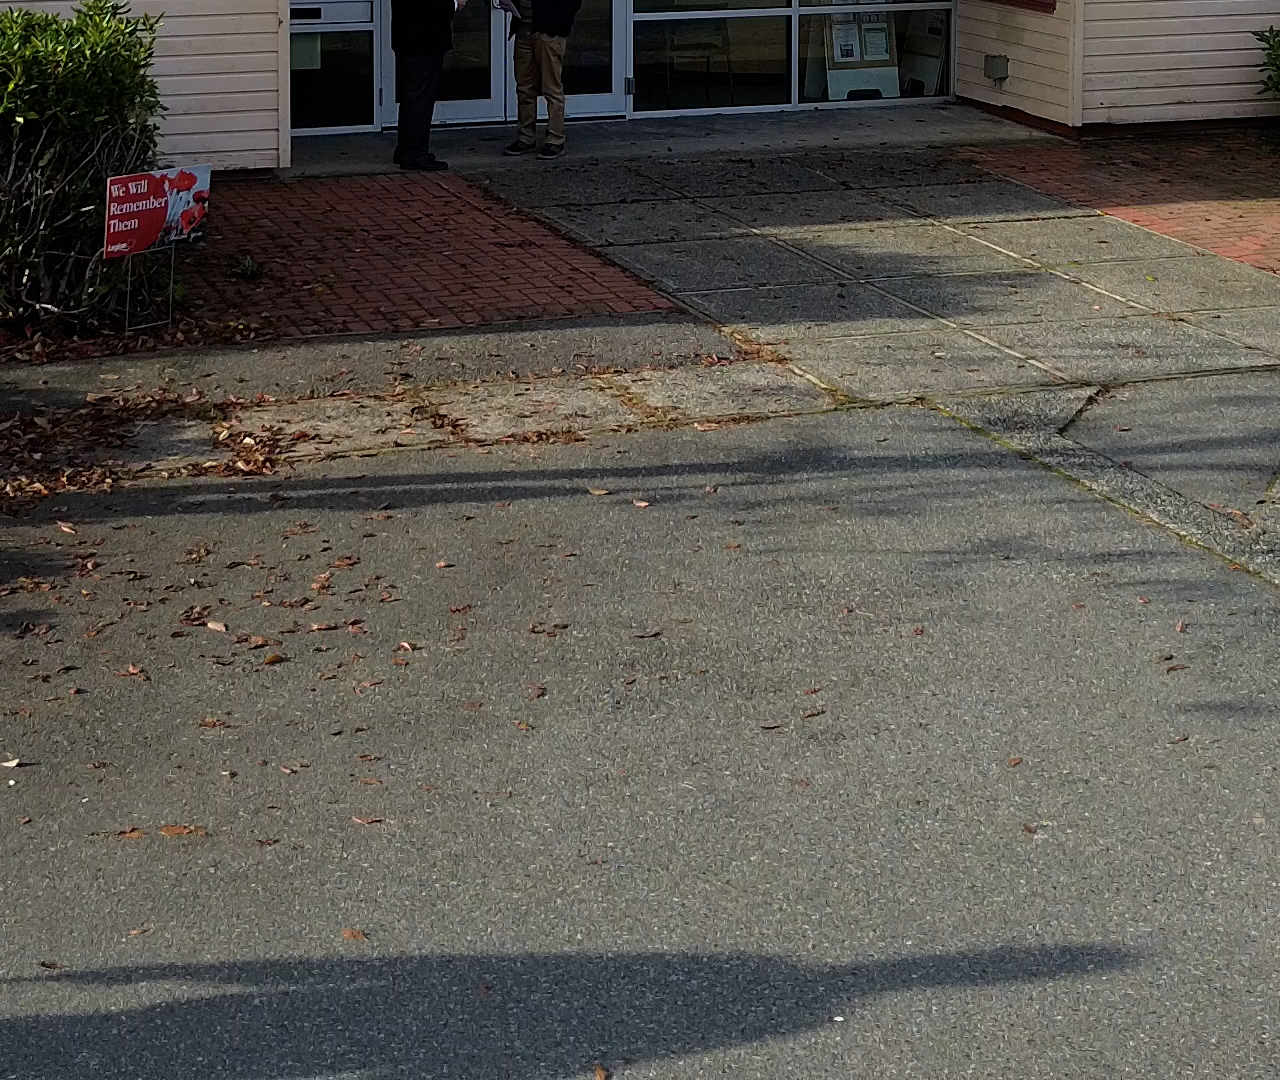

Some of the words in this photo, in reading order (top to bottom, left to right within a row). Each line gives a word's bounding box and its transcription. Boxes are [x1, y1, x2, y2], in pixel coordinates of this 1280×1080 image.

[110, 183, 126, 198] We
[128, 179, 148, 193] Will
[109, 196, 167, 215] Remember
[109, 219, 138, 233] Them
